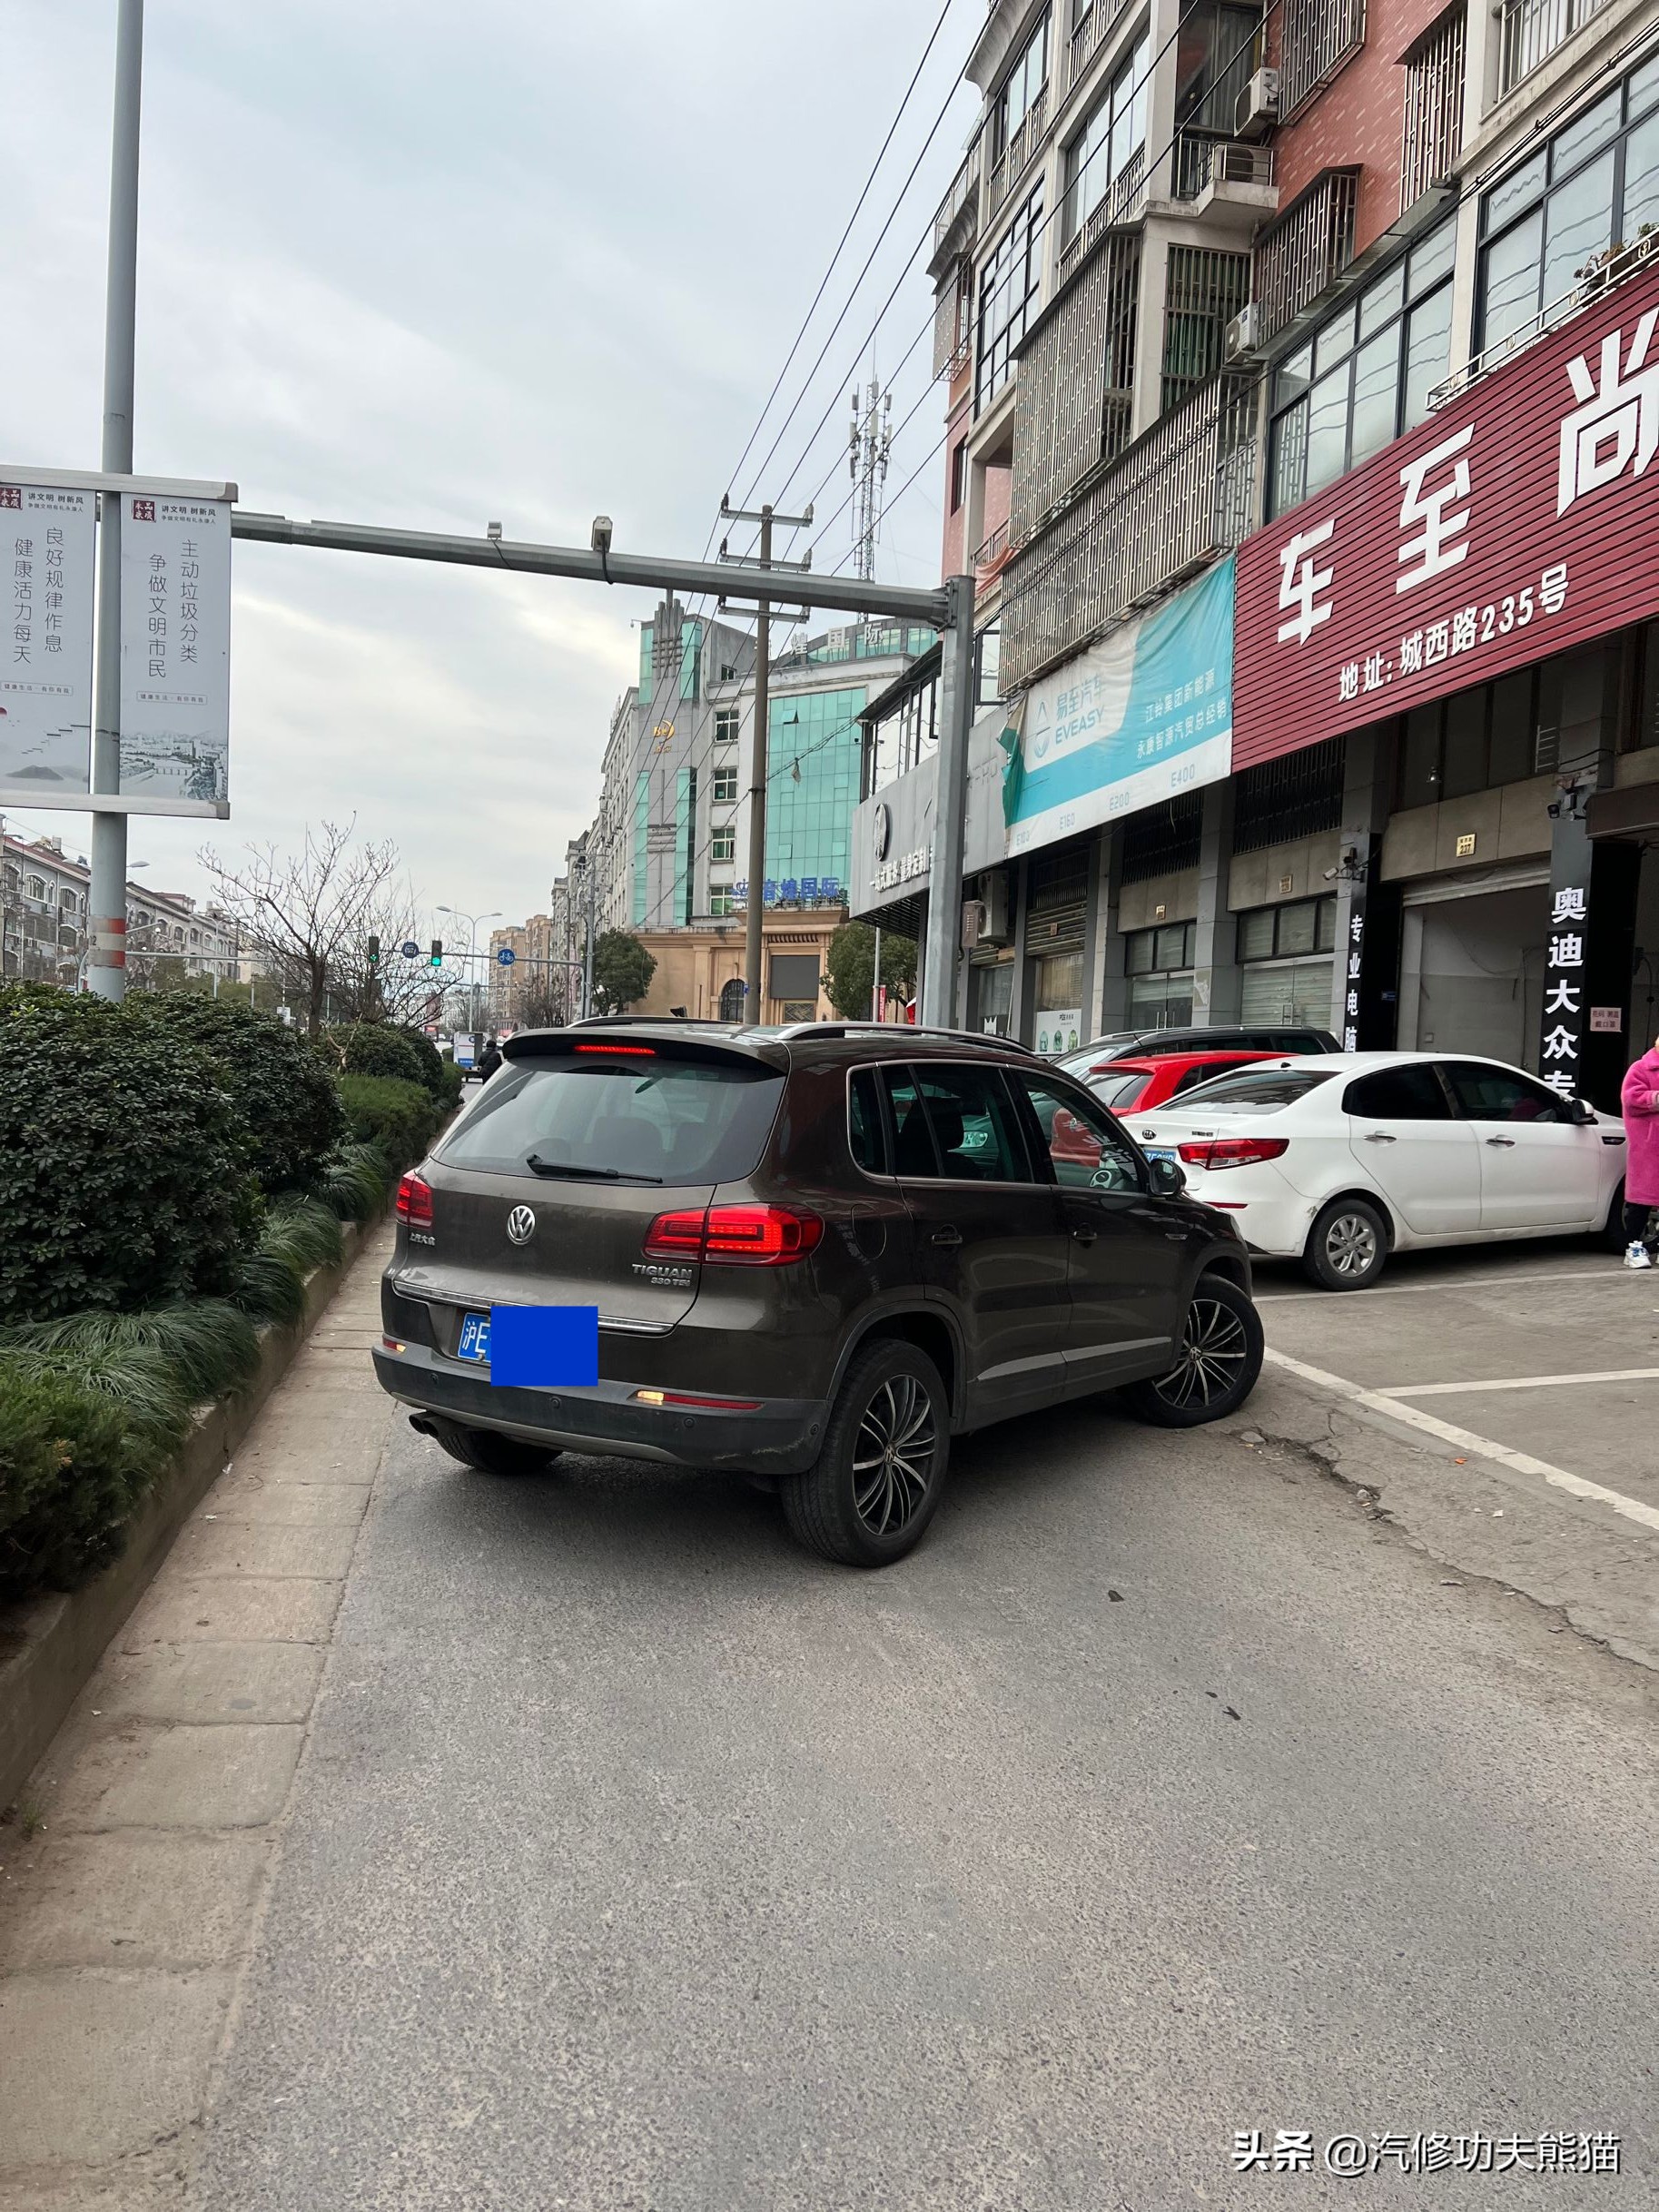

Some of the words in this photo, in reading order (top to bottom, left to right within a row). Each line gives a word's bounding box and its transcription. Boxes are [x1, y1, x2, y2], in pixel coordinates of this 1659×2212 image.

[28, 492, 54, 502] 讲文明
[57, 495, 84, 505] 树新风
[1277, 307, 1659, 647] 车至尚
[162, 505, 187, 514] 讲文明
[190, 507, 216, 517] 树新风
[14, 538, 34, 665] 健康活力每天
[44, 527, 64, 653] 良好规律作息
[180, 538, 199, 664] 主动垃圾分类
[148, 554, 167, 678] 争做文明市民
[1057, 674, 1105, 721] 易至汽车
[1145, 667, 1215, 724] 江铃集团新能源
[1056, 705, 1104, 745] EVEASY
[1137, 696, 1227, 759] 永康智源汽贸总经销
[1170, 763, 1195, 788] E400
[1109, 792, 1130, 812] E200
[631, 1263, 693, 1279] TIGUAN
[650, 1277, 671, 1286] 330
